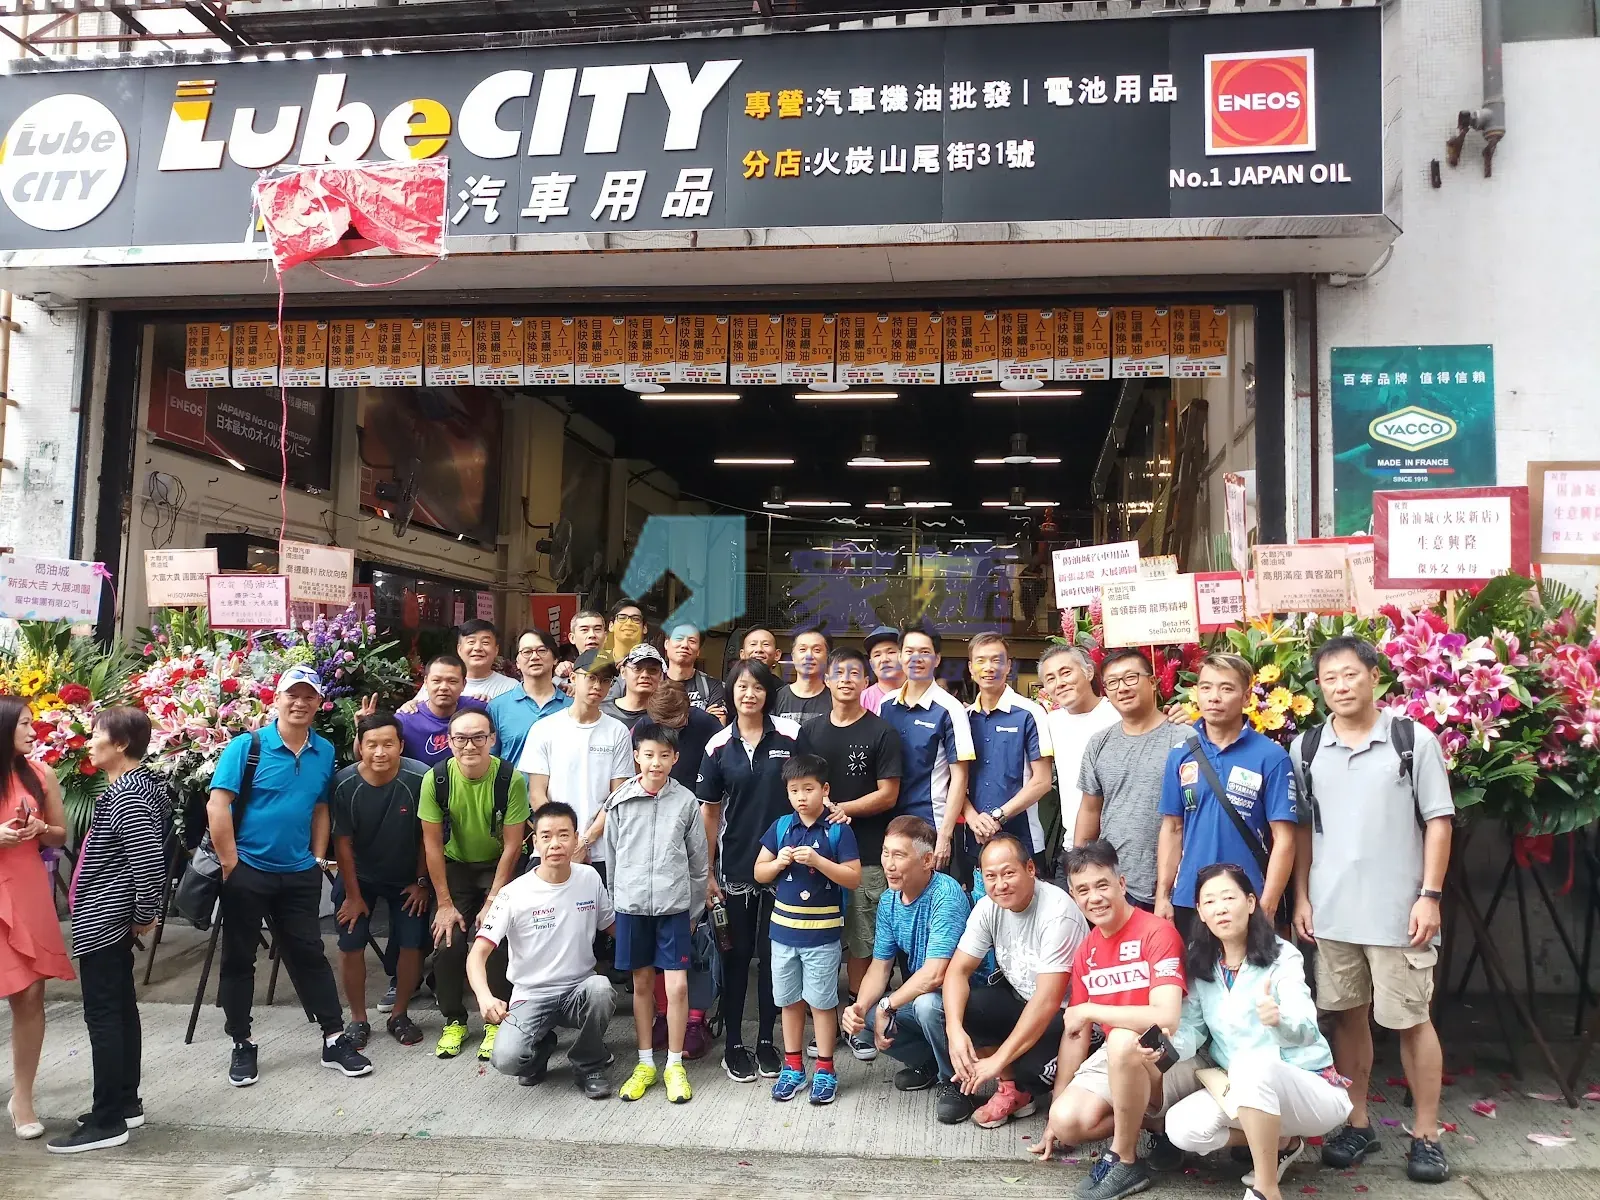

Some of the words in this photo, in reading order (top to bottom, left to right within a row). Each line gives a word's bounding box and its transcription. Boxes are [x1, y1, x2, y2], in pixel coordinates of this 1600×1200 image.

[1217, 91, 1300, 113] ENEOS
[13, 120, 116, 157] Lube
[1168, 167, 1222, 189] No.1
[1227, 163, 1305, 185] JAPAN
[1309, 162, 1352, 184] OIL
[12, 168, 107, 203] CITY
[453, 167, 714, 225] 汽車用品
[1342, 371, 1408, 386] 百年品牌
[170, 396, 203, 418] ENEOS
[279, 425, 311, 445] Cmpany
[1383, 423, 1443, 436] YACCO
[1377, 459, 1401, 467] MADE
[1415, 458, 1449, 466] FRANCE
[1417, 534, 1477, 550] 生意興隆
[34, 563, 70, 577] 偈油城
[1263, 570, 1303, 581] 高朋滿座
[1149, 601, 1188, 613] 龍馬精神
[532, 907, 555, 916] DENSO
